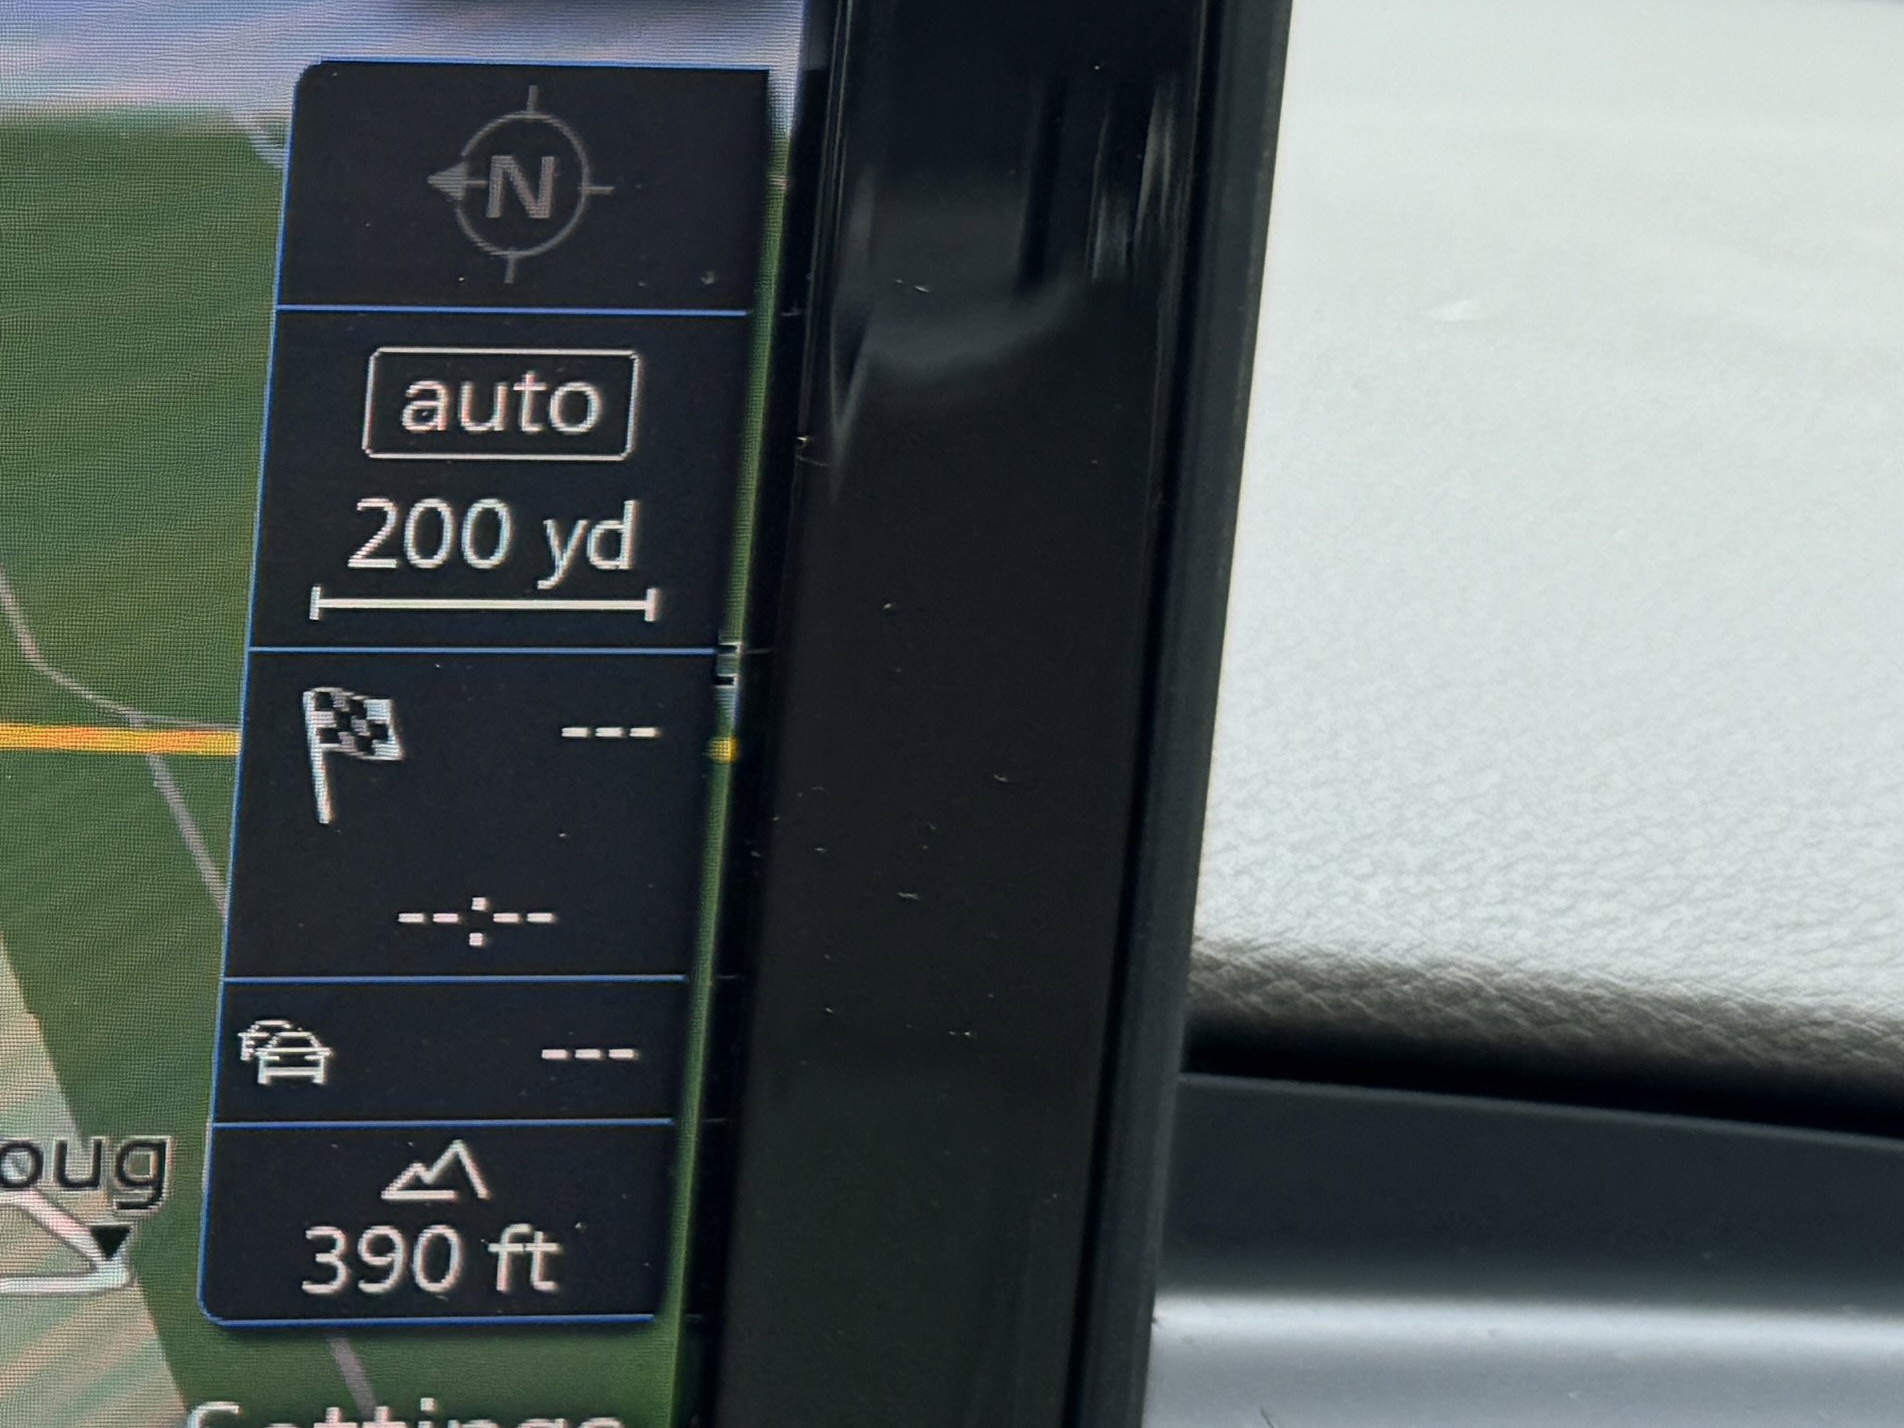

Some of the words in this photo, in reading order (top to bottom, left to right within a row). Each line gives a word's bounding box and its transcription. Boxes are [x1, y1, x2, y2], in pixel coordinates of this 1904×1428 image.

[485, 155, 555, 219] N
[401, 373, 600, 433] auto
[347, 497, 512, 568] 200
[537, 501, 637, 590] yd
[301, 1223, 463, 1297] 390
[488, 1221, 560, 1294] ft
